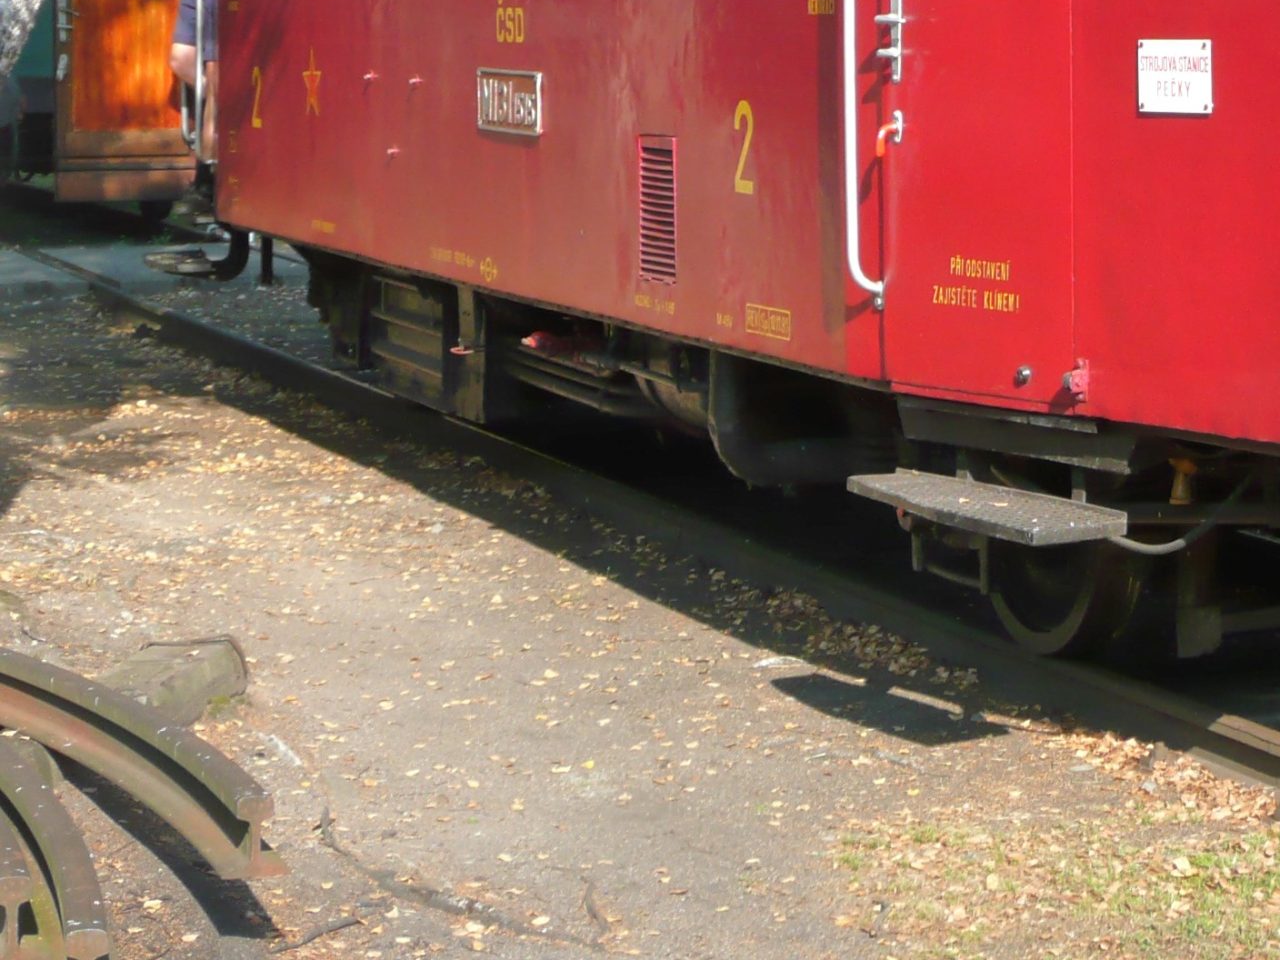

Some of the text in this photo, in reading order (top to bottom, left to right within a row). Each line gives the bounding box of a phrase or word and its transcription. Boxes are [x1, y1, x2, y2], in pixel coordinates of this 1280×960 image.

[1178, 56, 1209, 73] STANICE
[252, 66, 263, 128] 2
[1156, 77, 1191, 97] PEČKY
[734, 100, 755, 195] 2
[950, 254, 1011, 281] PŘI ODSTAVENÍ
[932, 284, 978, 308] ZAJISTĚTE
